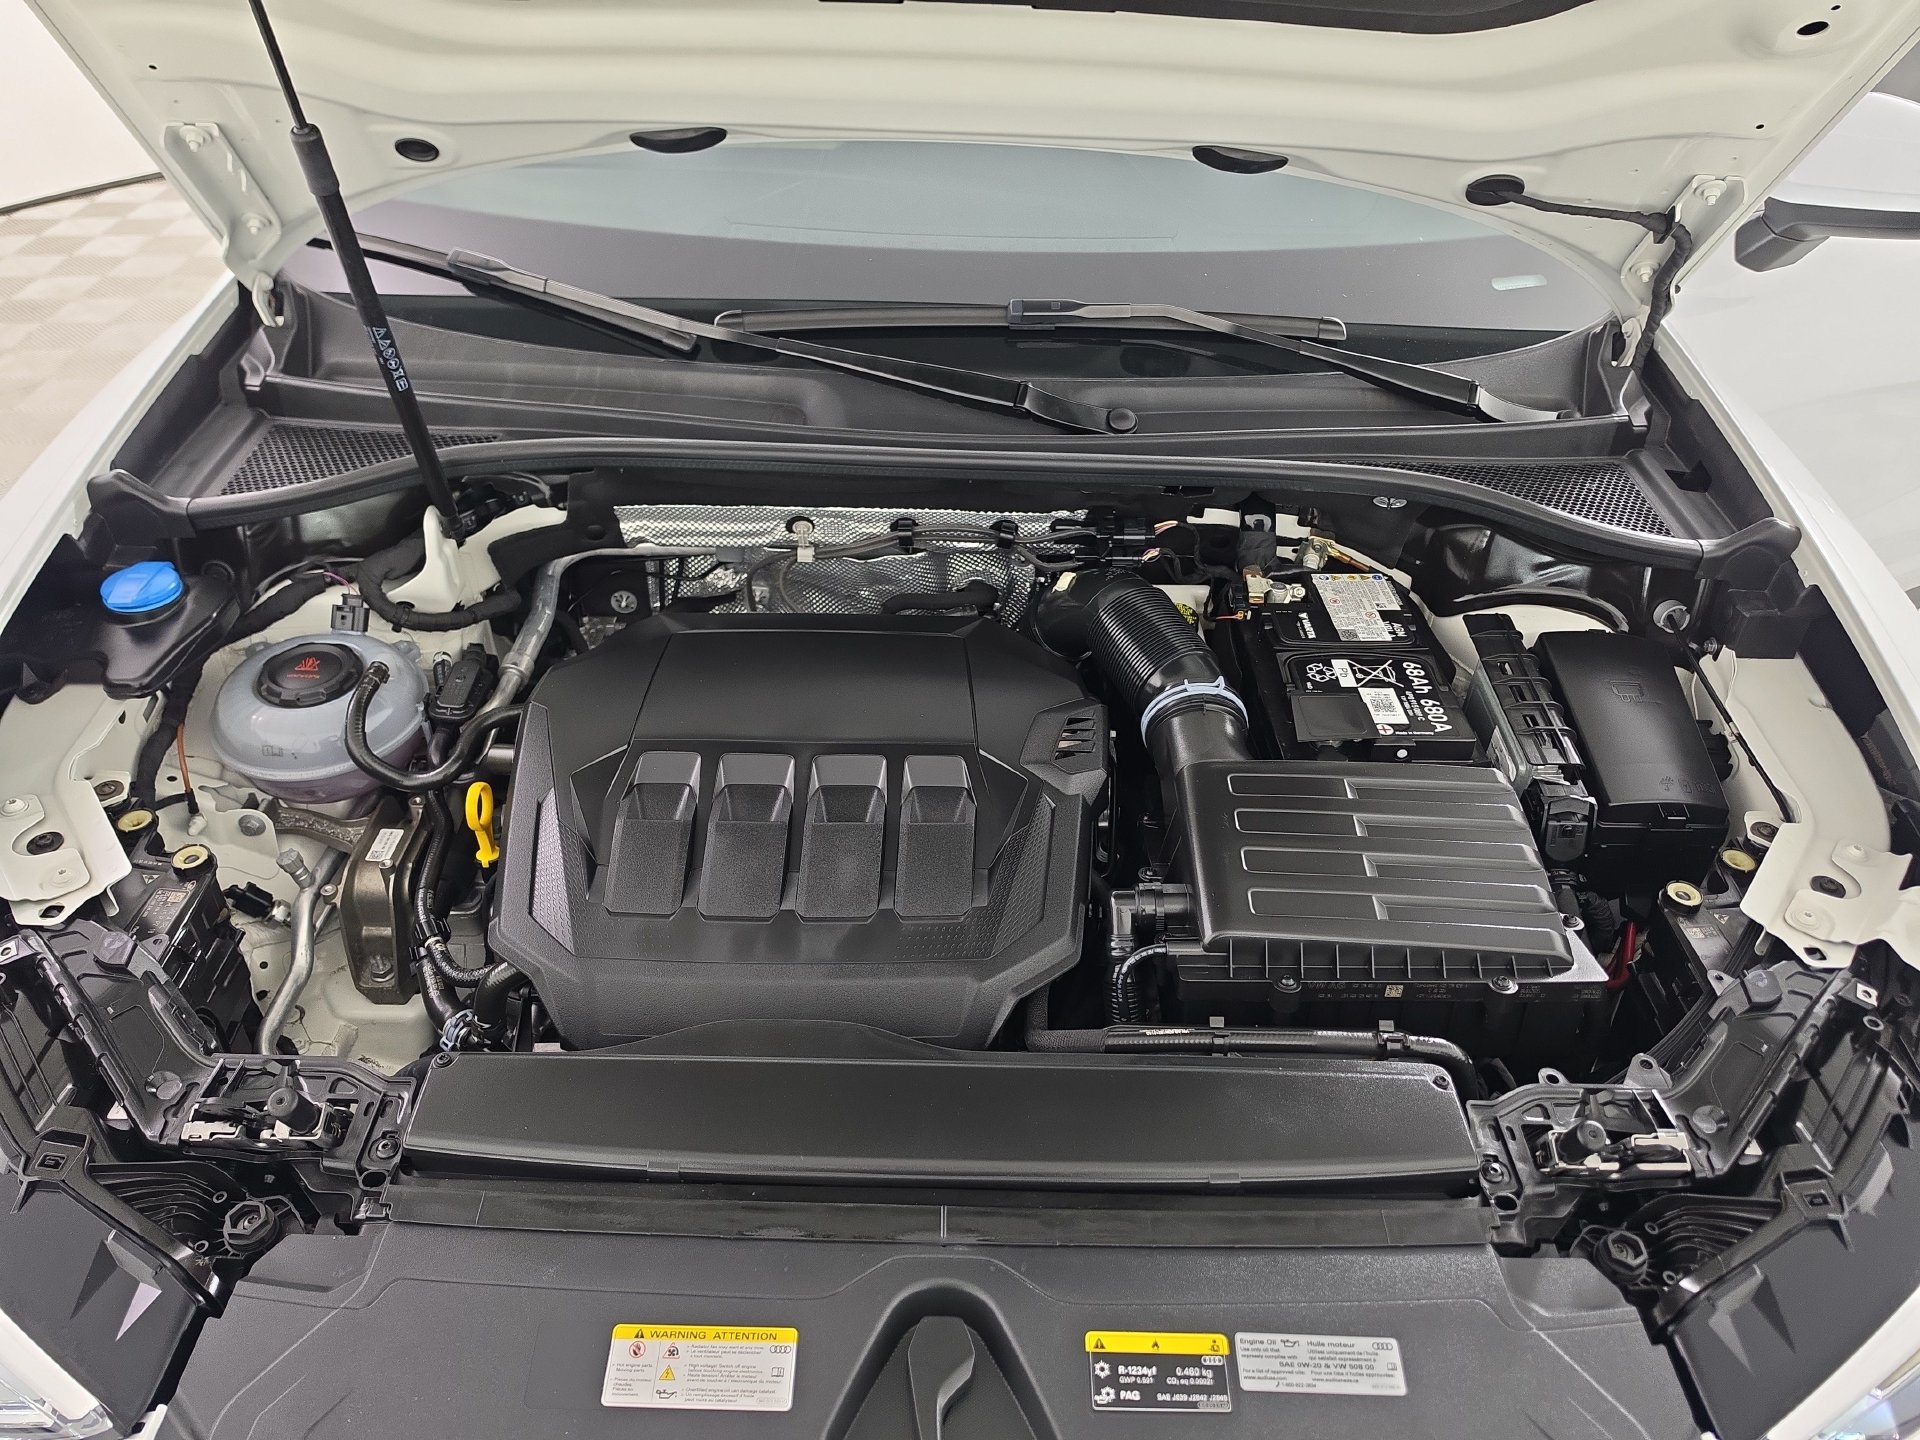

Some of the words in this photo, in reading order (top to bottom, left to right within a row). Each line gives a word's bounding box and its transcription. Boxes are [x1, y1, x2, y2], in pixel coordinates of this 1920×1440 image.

[1338, 668, 1348, 677] Pb
[1402, 662, 1432, 693] 68Ah
[1420, 699, 1452, 732] 680A
[650, 1330, 707, 1339] WARNING
[713, 1332, 777, 1340] ATTENTION
[1297, 1361, 1322, 1369] 0W-20
[1118, 1365, 1157, 1377] R-1234yf
[1201, 1367, 1213, 1378] kg
[1120, 1390, 1141, 1400] PAG
